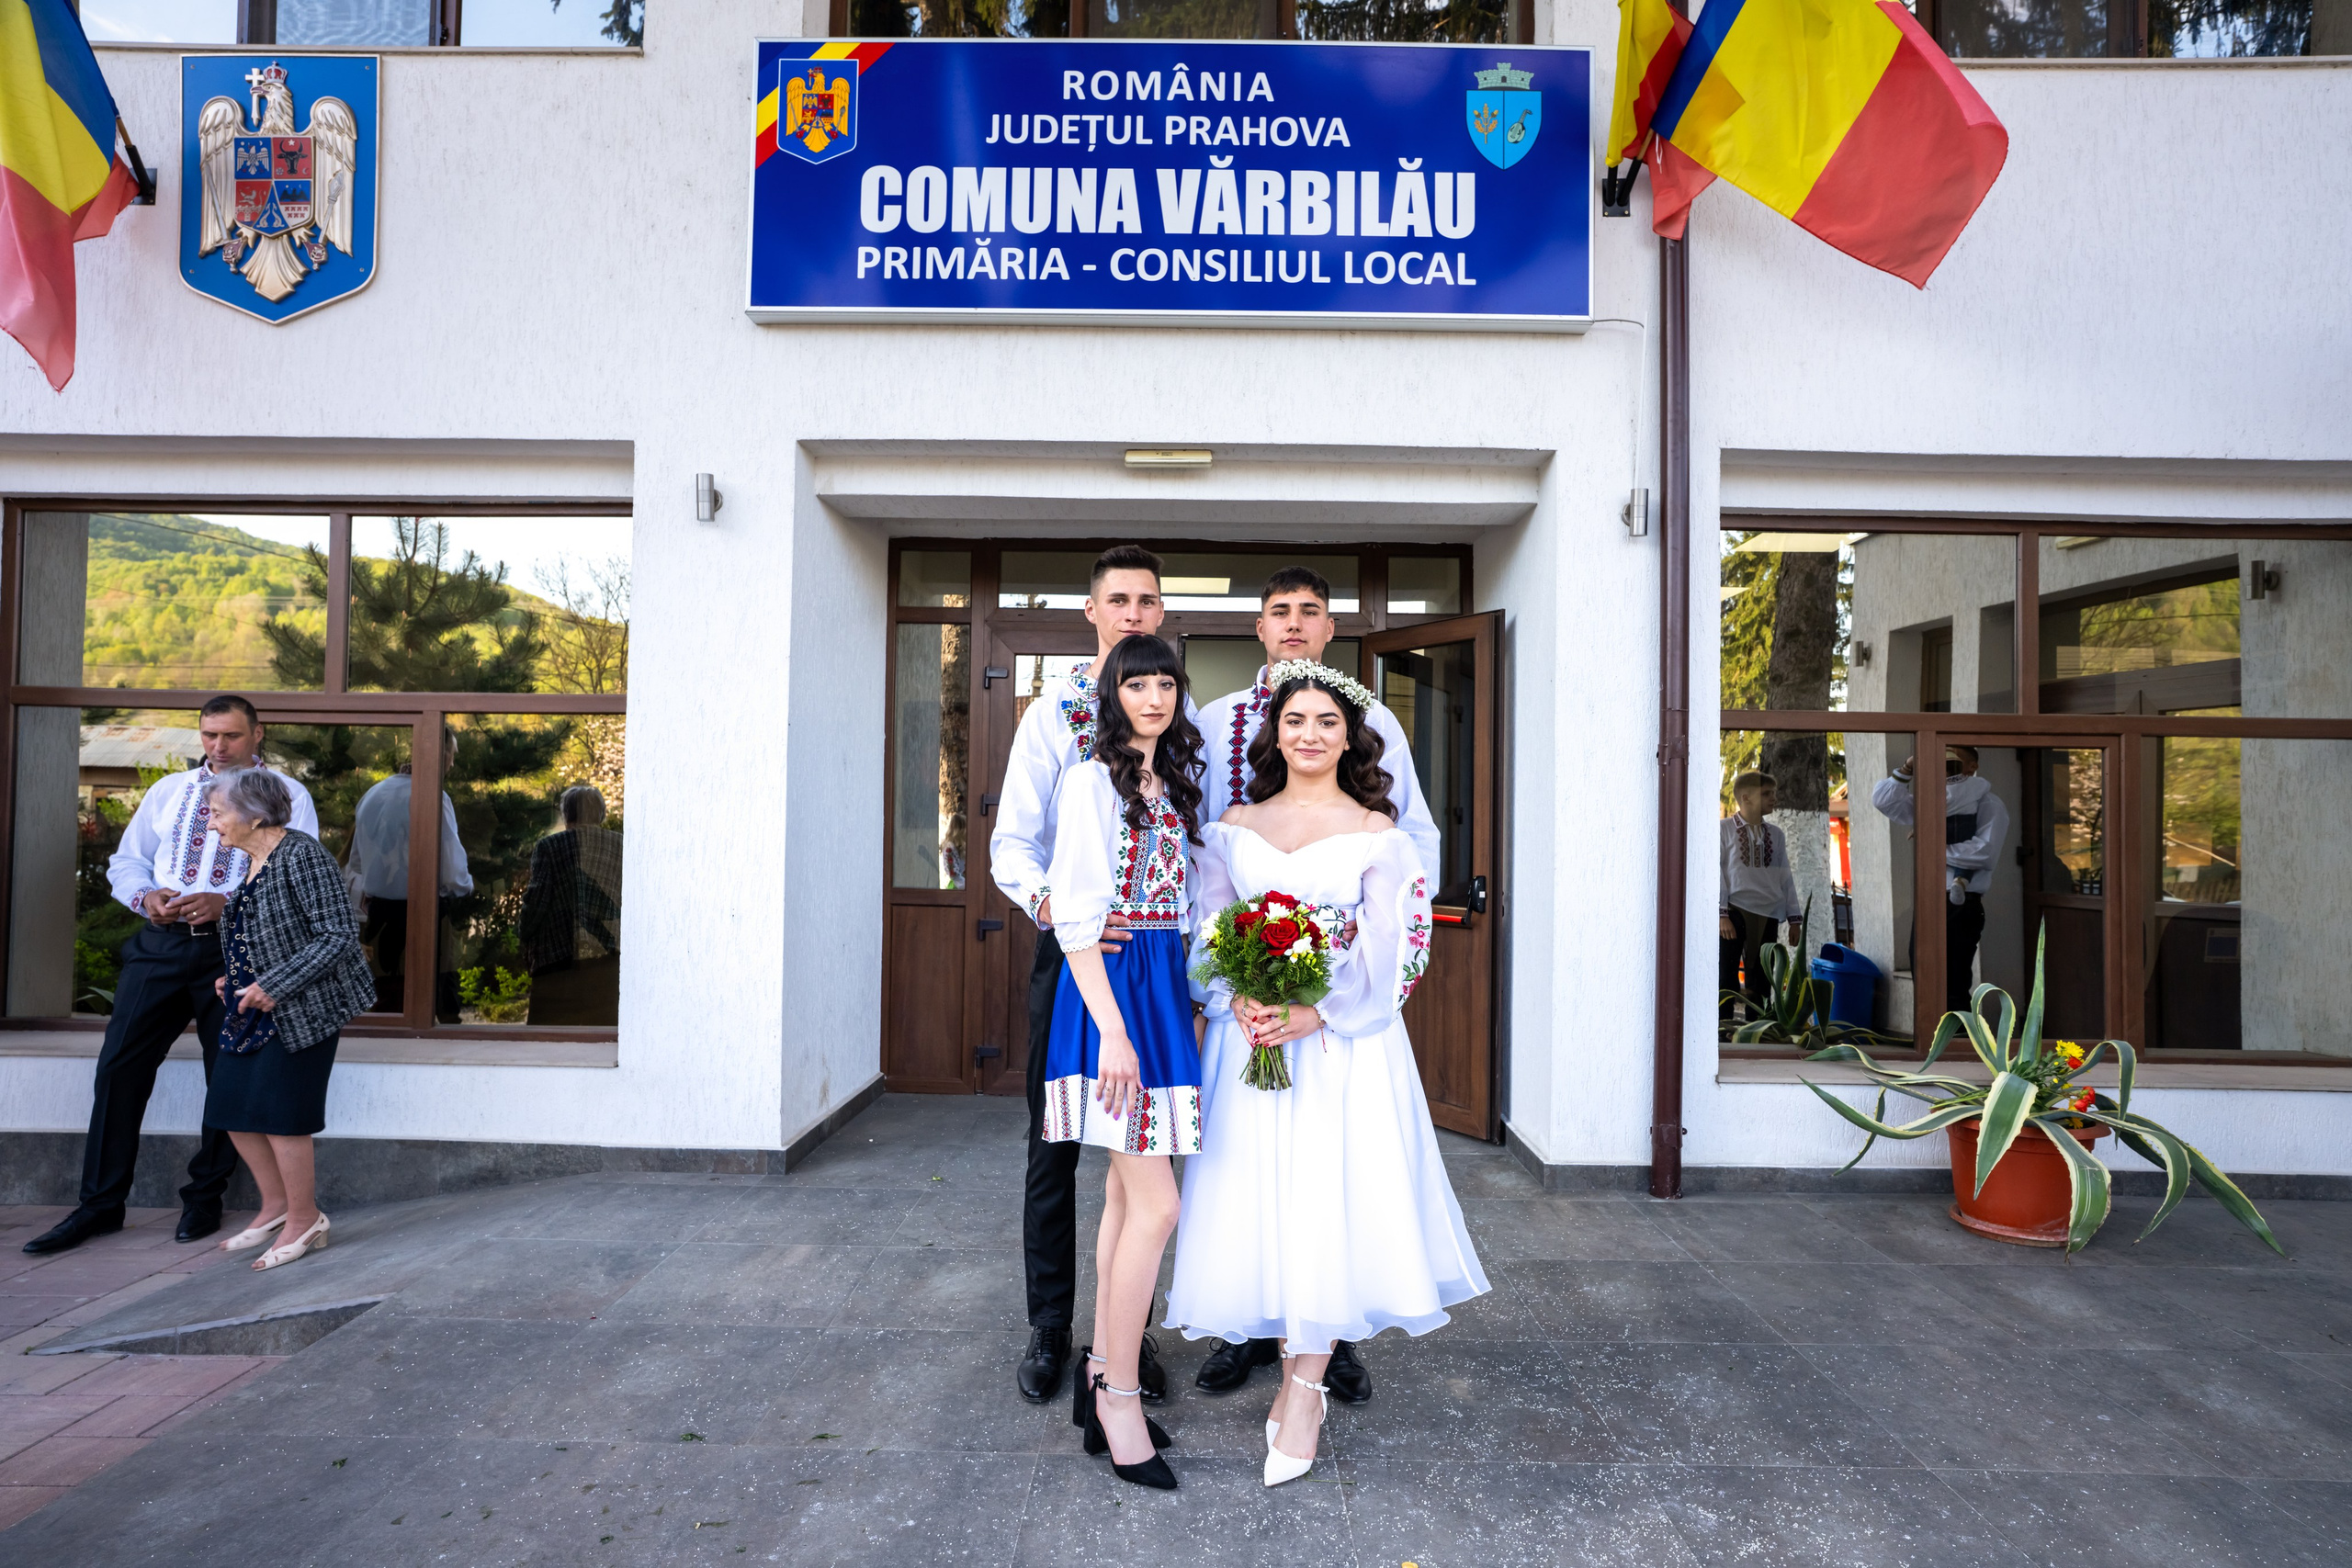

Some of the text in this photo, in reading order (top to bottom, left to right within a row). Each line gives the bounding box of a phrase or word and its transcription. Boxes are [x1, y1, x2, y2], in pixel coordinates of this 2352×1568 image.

[1063, 63, 1274, 102] ROMÂNIA
[986, 114, 1351, 152] JUDEȚUL PRAHOVA
[860, 155, 1476, 240] COMUNA VĂRBILĂU
[856, 238, 1070, 280] PRIMĂRIA
[1110, 247, 1331, 284] CONSILIUL
[1344, 251, 1476, 286] LOCAL
